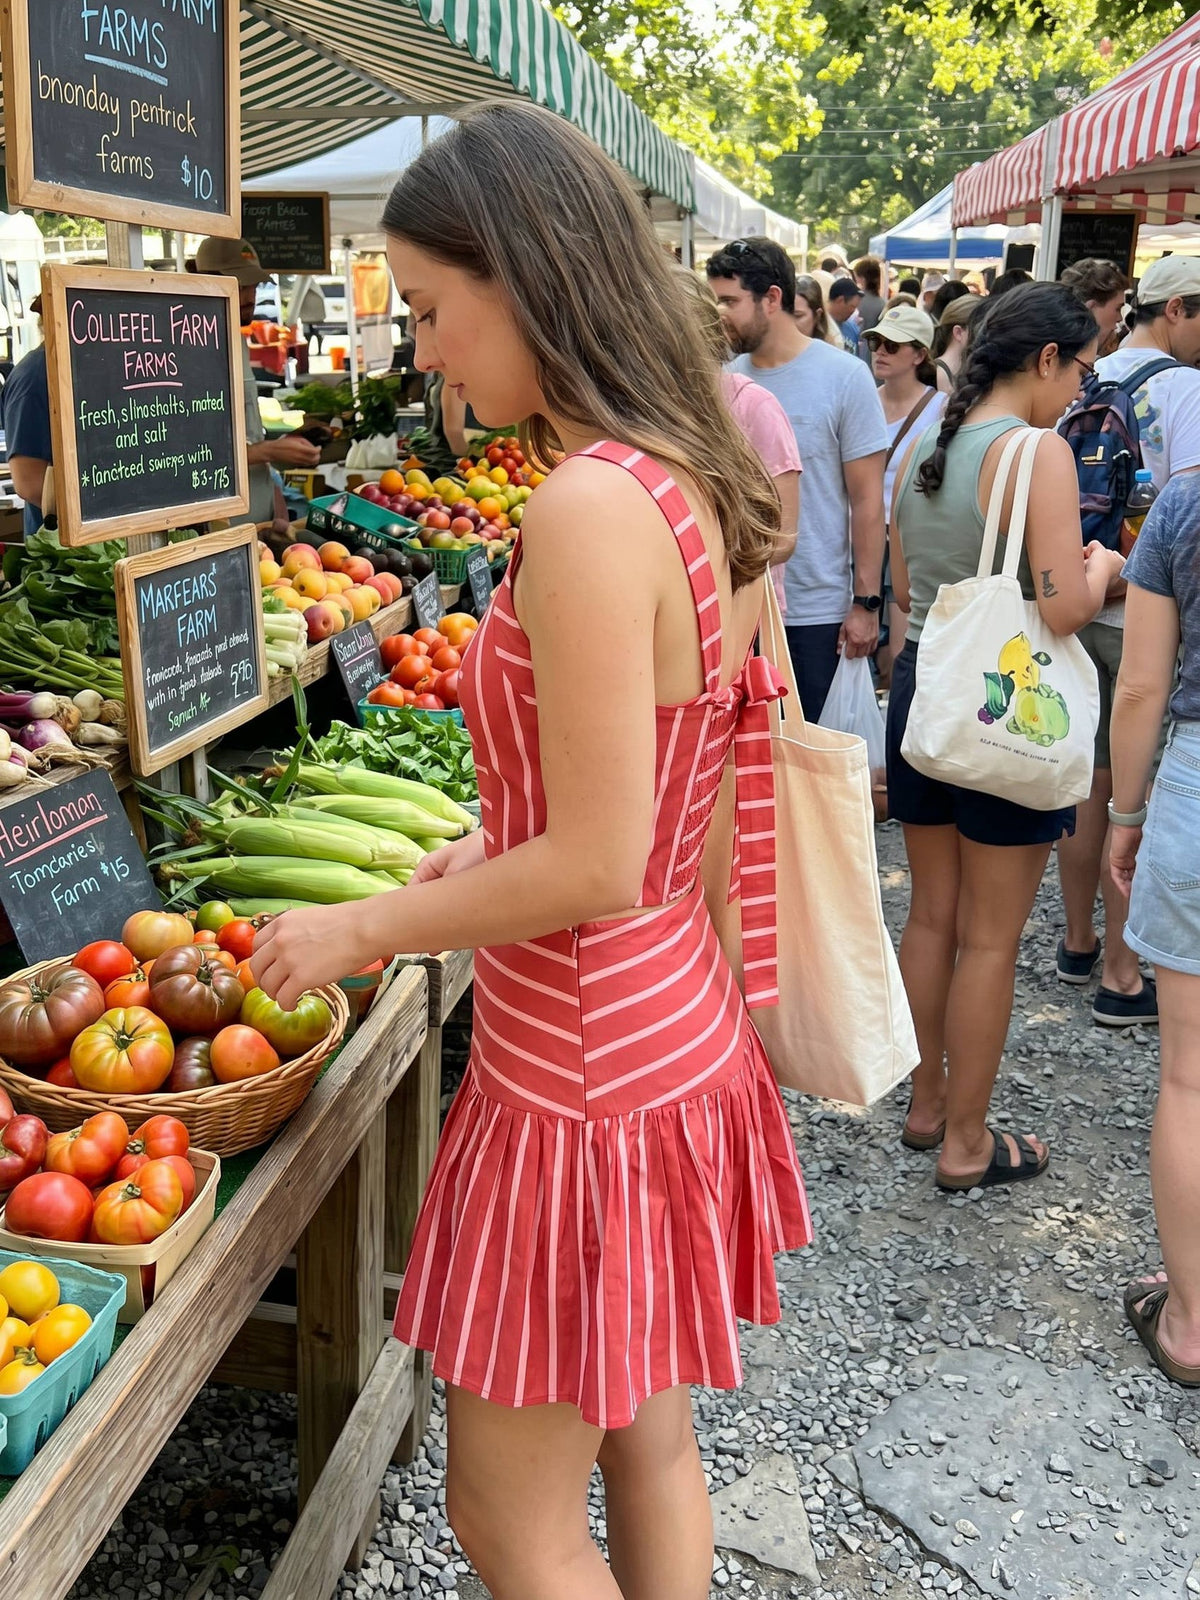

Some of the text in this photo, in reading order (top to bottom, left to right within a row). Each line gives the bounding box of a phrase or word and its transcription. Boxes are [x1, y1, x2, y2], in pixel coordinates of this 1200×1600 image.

[81, 0, 168, 69] FARMS
[162, 0, 216, 33] RM
[130, 94, 198, 137] pentrick
[96, 134, 154, 180] farms
[181, 155, 213, 200] $10
[70, 300, 219, 350] COLLEFEL FARM
[123, 351, 178, 380] FARMS
[79, 401, 120, 430] fresh,
[115, 421, 168, 449] and salt
[187, 443, 213, 464] with
[177, 604, 218, 648] FARM
[167, 686, 177, 700] in
[0, 792, 103, 859] Heirloman
[50, 876, 101, 916] Farm
